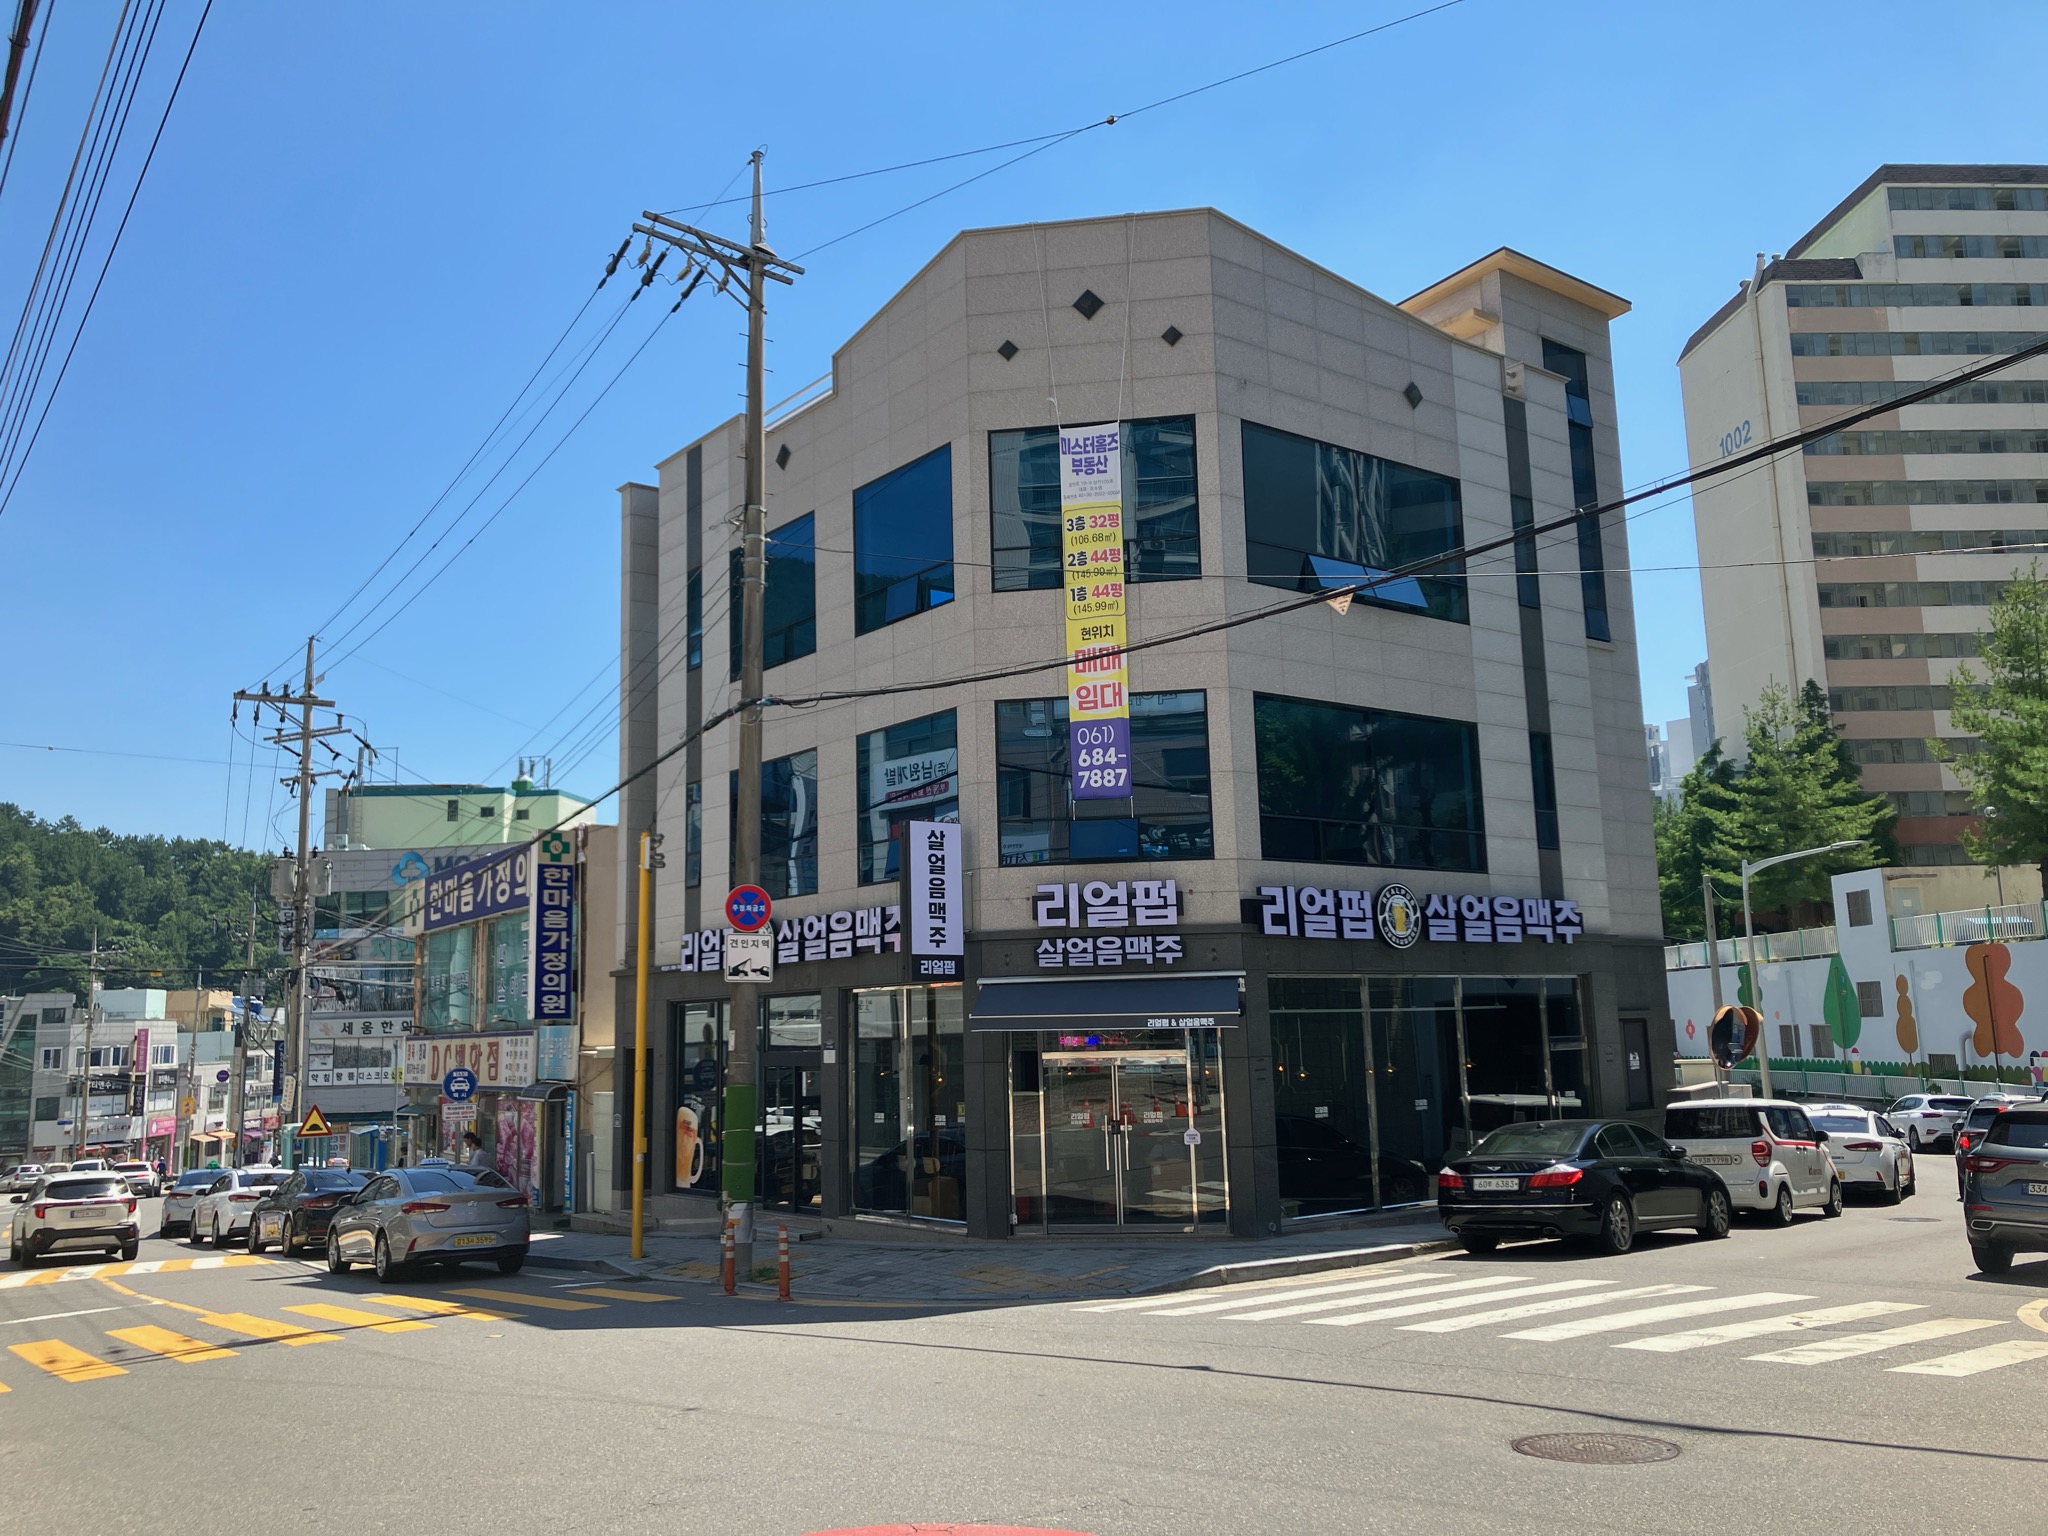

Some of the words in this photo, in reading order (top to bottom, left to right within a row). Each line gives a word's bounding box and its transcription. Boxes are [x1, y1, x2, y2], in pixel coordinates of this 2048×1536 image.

[1060, 432, 1119, 455] 미스터홈즈
[1719, 420, 1752, 458] 1002
[1071, 454, 1108, 476] 부동산
[1066, 515, 1086, 532] 3층
[1088, 513, 1120, 529] 32평
[1067, 550, 1088, 567] 2층
[1090, 547, 1121, 563] 44평
[1070, 586, 1087, 602] 1층
[1091, 582, 1123, 598] 44평
[1081, 624, 1114, 640] 현위치
[1074, 644, 1122, 674] 매매
[1076, 682, 1122, 711] 임대
[1077, 724, 1115, 745] 061)
[1078, 746, 1127, 767] 684-
[1078, 768, 1127, 789] 7887
[927, 829, 947, 949] 살얼음맥주
[732, 904, 766, 912] 주정차금지
[1036, 879, 1178, 928] 리얼펍
[1260, 885, 1375, 940] 리얼펍
[1424, 892, 1583, 944] 살얼음맥주
[540, 867, 571, 1014] 한마음가정의원
[729, 938, 770, 949] 견인지역
[1036, 934, 1183, 968] 살얼음맥주
[920, 959, 956, 975] 리얼펍
[1495, 1180, 1515, 1188] 6383
[2029, 1184, 2048, 1194] 334
